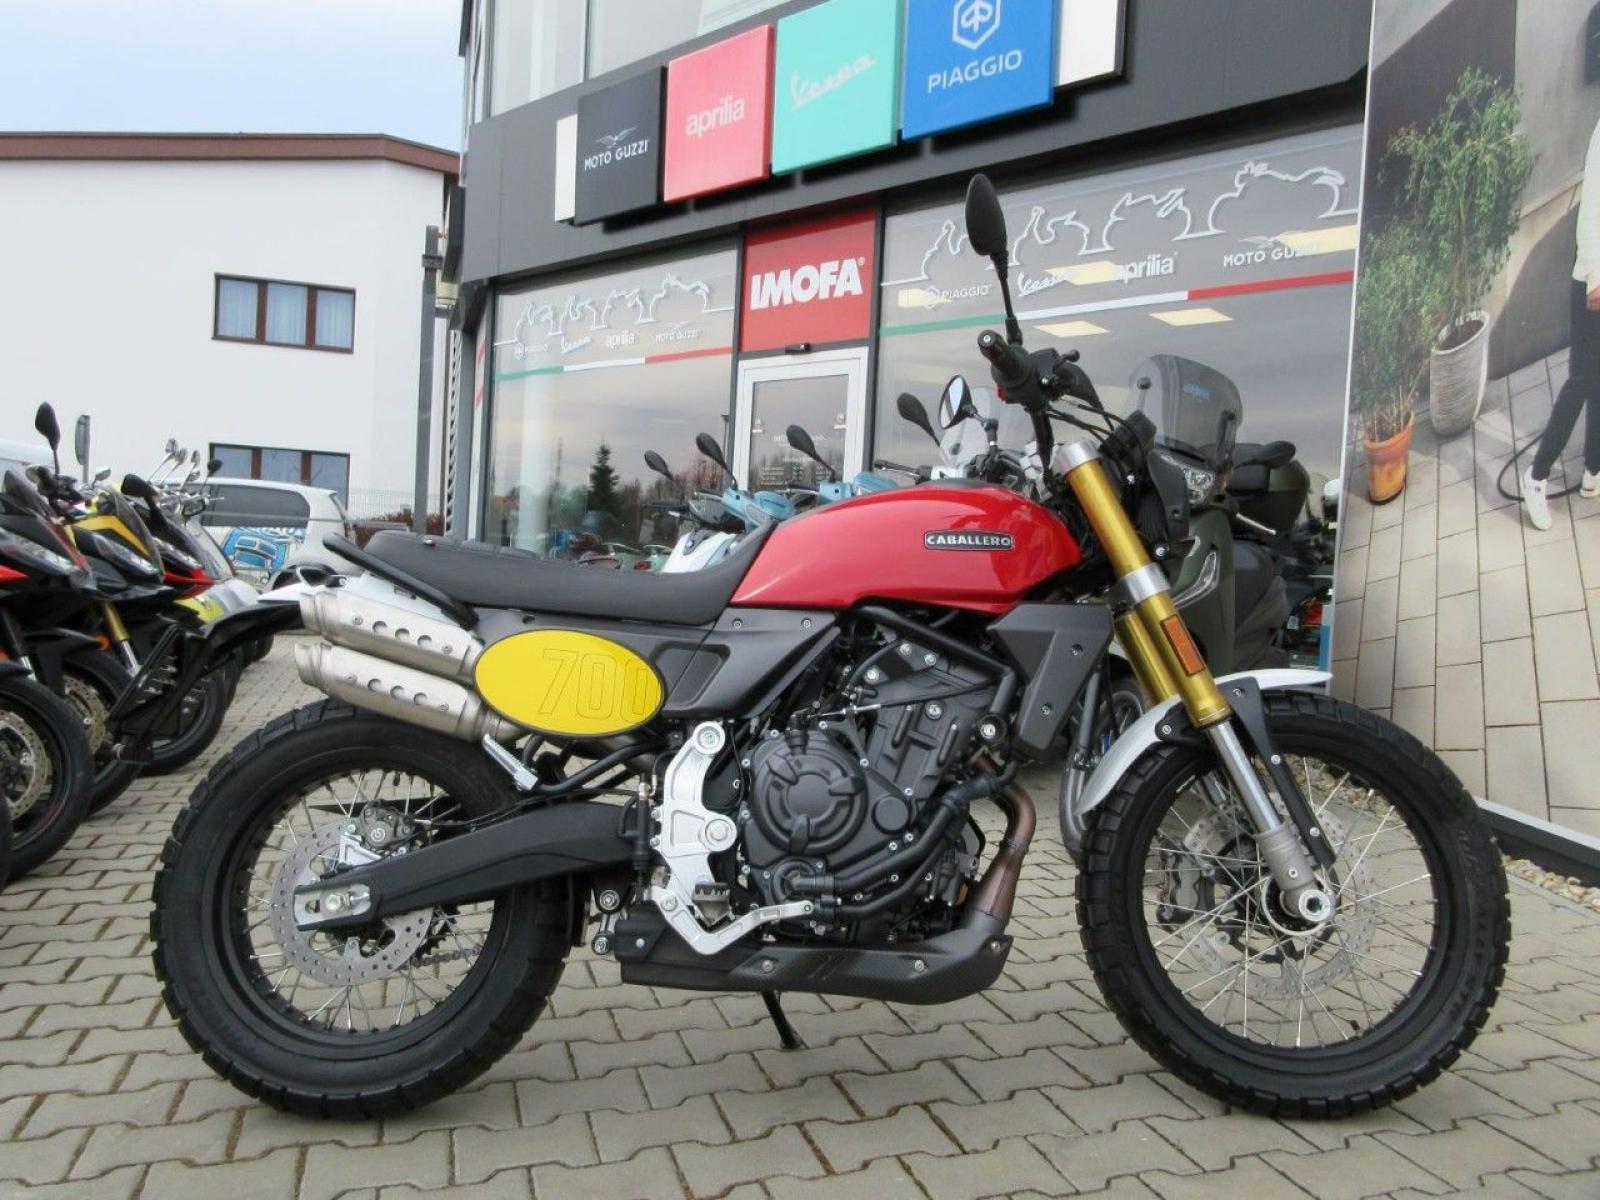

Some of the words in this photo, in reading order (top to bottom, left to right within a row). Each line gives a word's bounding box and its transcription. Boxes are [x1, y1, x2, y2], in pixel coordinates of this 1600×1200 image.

[928, 49, 1022, 93] PIAGGIO
[685, 95, 745, 138] aprilia
[584, 151, 611, 171] MOTO
[615, 139, 648, 160] GUZZI
[1223, 250, 1266, 267] MOTO
[942, 284, 989, 299] PIAGGIO
[927, 535, 1011, 546] CABALLERO
[538, 648, 660, 724] 700
